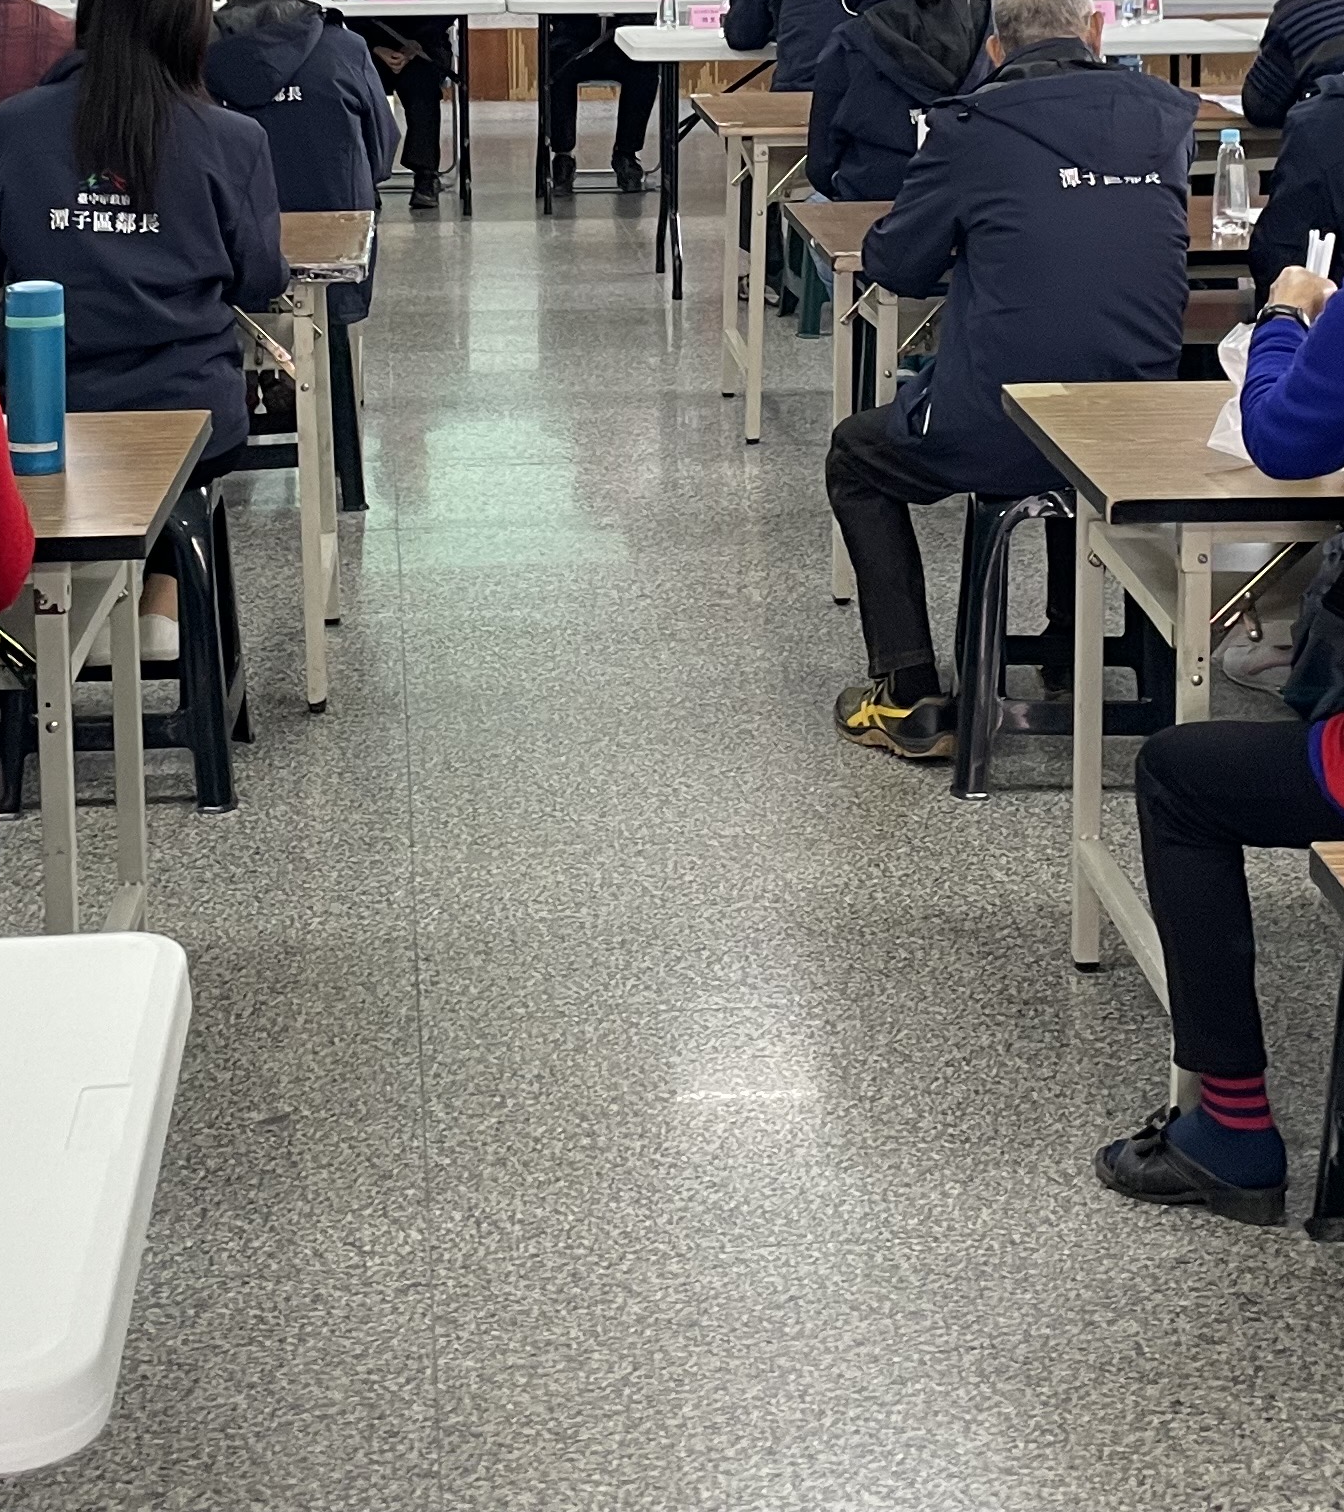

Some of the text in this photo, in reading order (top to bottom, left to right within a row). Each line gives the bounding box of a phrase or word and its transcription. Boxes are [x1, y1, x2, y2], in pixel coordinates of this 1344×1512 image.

[49, 208, 160, 234] 潭子區鄰長
